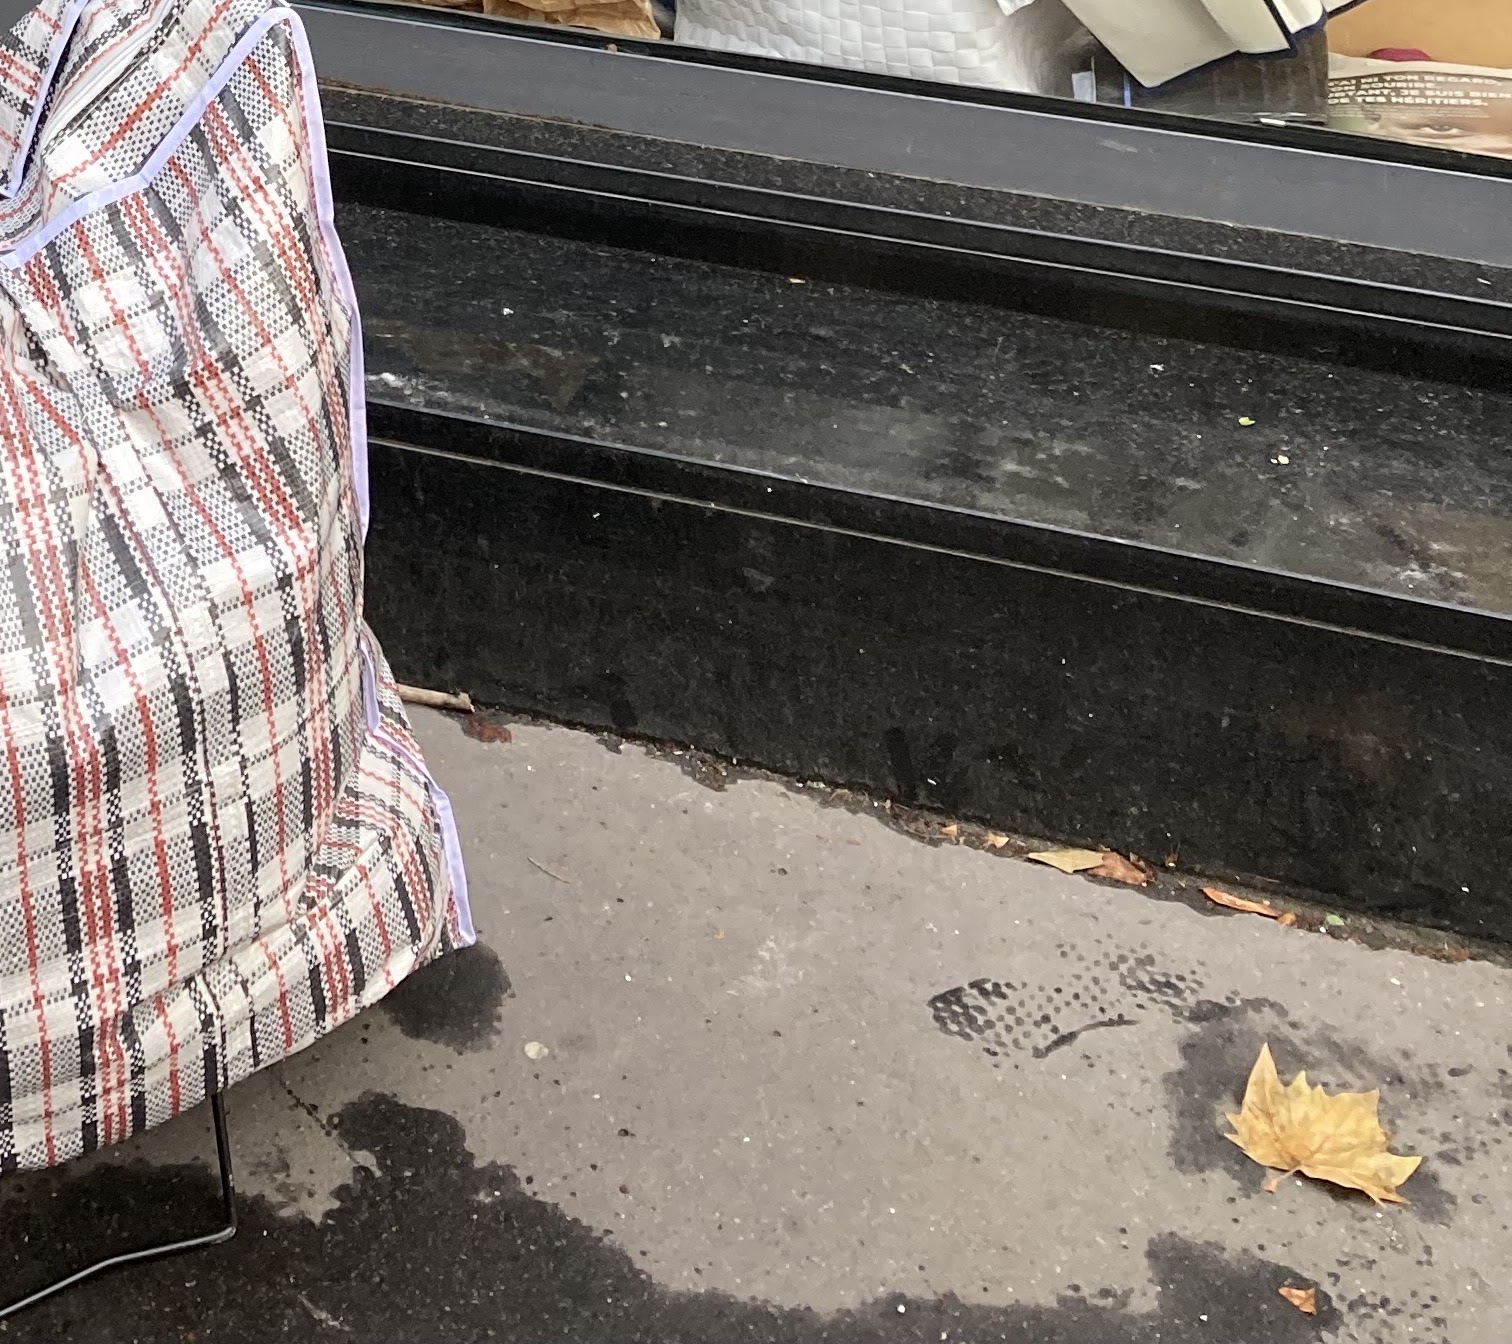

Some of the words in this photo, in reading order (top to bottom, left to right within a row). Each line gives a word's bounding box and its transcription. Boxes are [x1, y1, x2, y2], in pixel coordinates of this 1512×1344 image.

[1383, 74, 1419, 82] TON
[1424, 75, 1503, 88] REGARD,
[1399, 89, 1420, 97] JE
[1424, 89, 1465, 98] SUIS
[1469, 90, 1512, 99] BIEN
[1390, 95, 1488, 106] HÉRITIERS.
